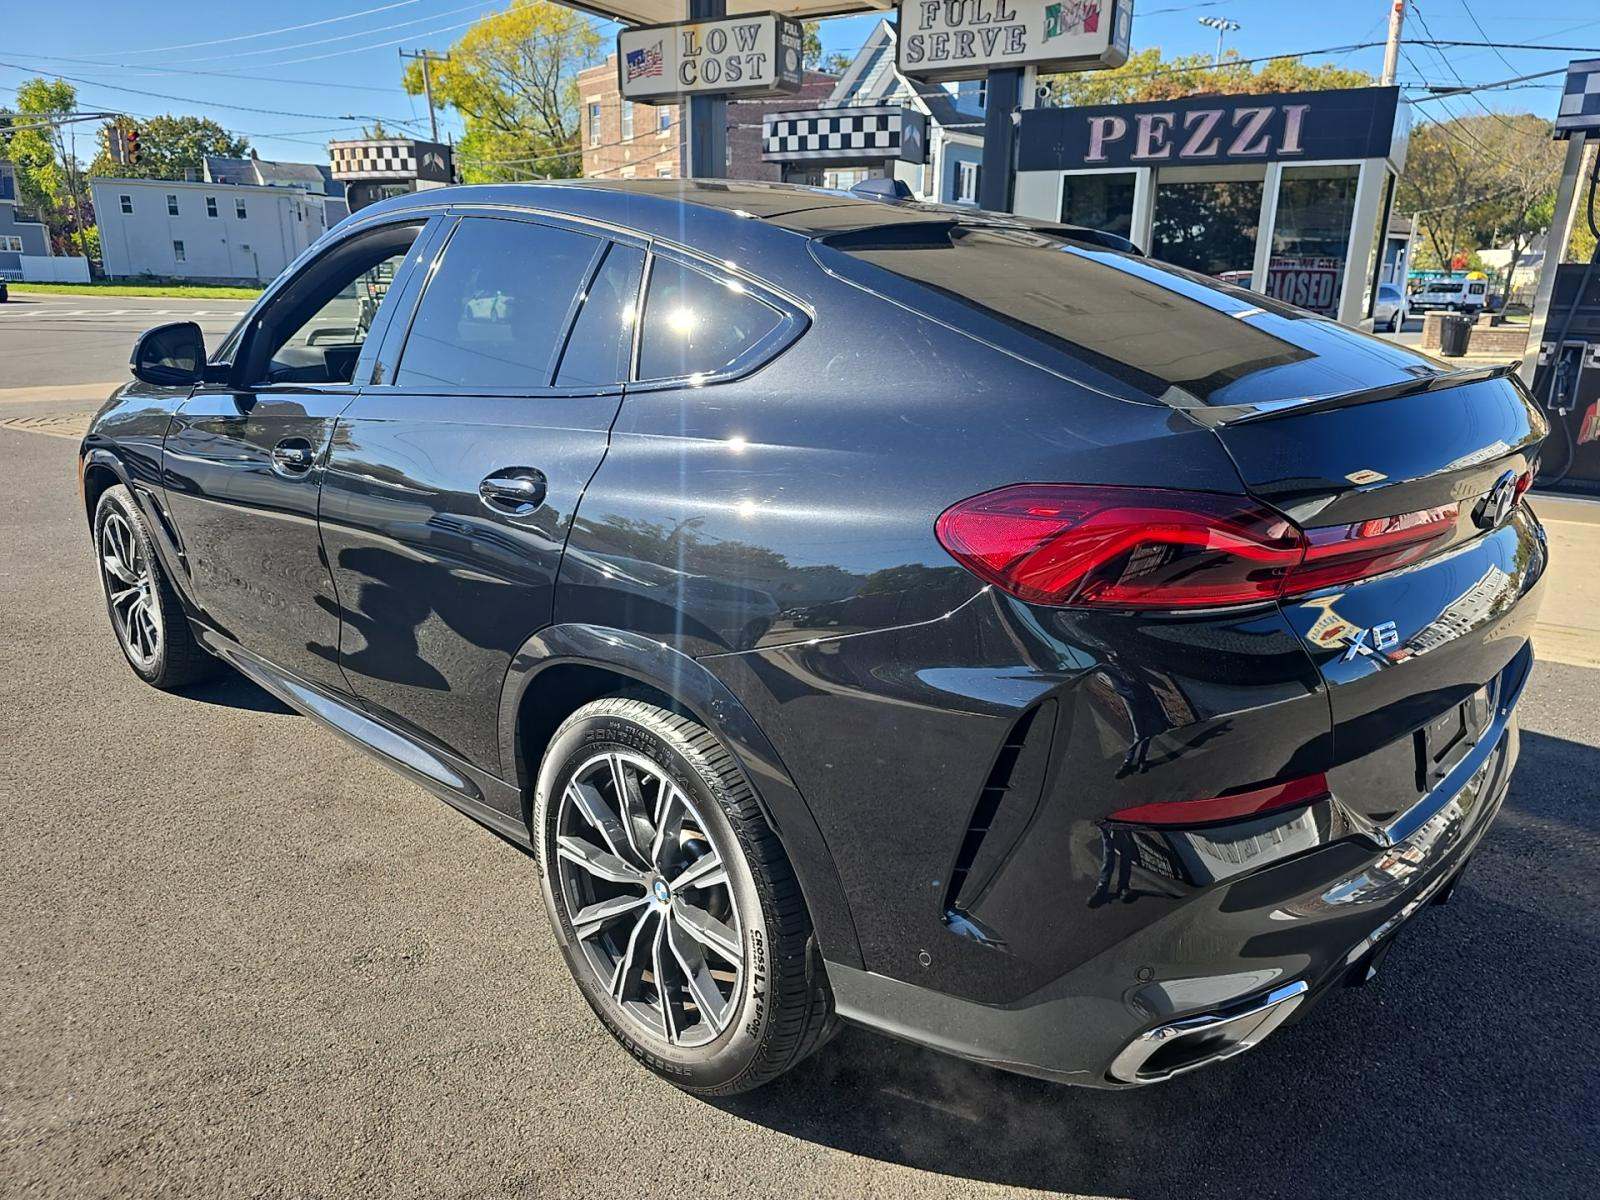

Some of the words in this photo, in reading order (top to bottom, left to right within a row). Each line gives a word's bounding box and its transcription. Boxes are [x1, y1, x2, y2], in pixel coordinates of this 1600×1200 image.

[919, 0, 1016, 30] FULL
[682, 24, 761, 58] LOW
[906, 25, 1027, 64] SERVE
[678, 53, 767, 86] COST
[1084, 104, 1311, 163] PEZZI
[1343, 620, 1400, 662] X6
[754, 929, 766, 973] CROSS
[749, 1003, 764, 1039] SPORT
